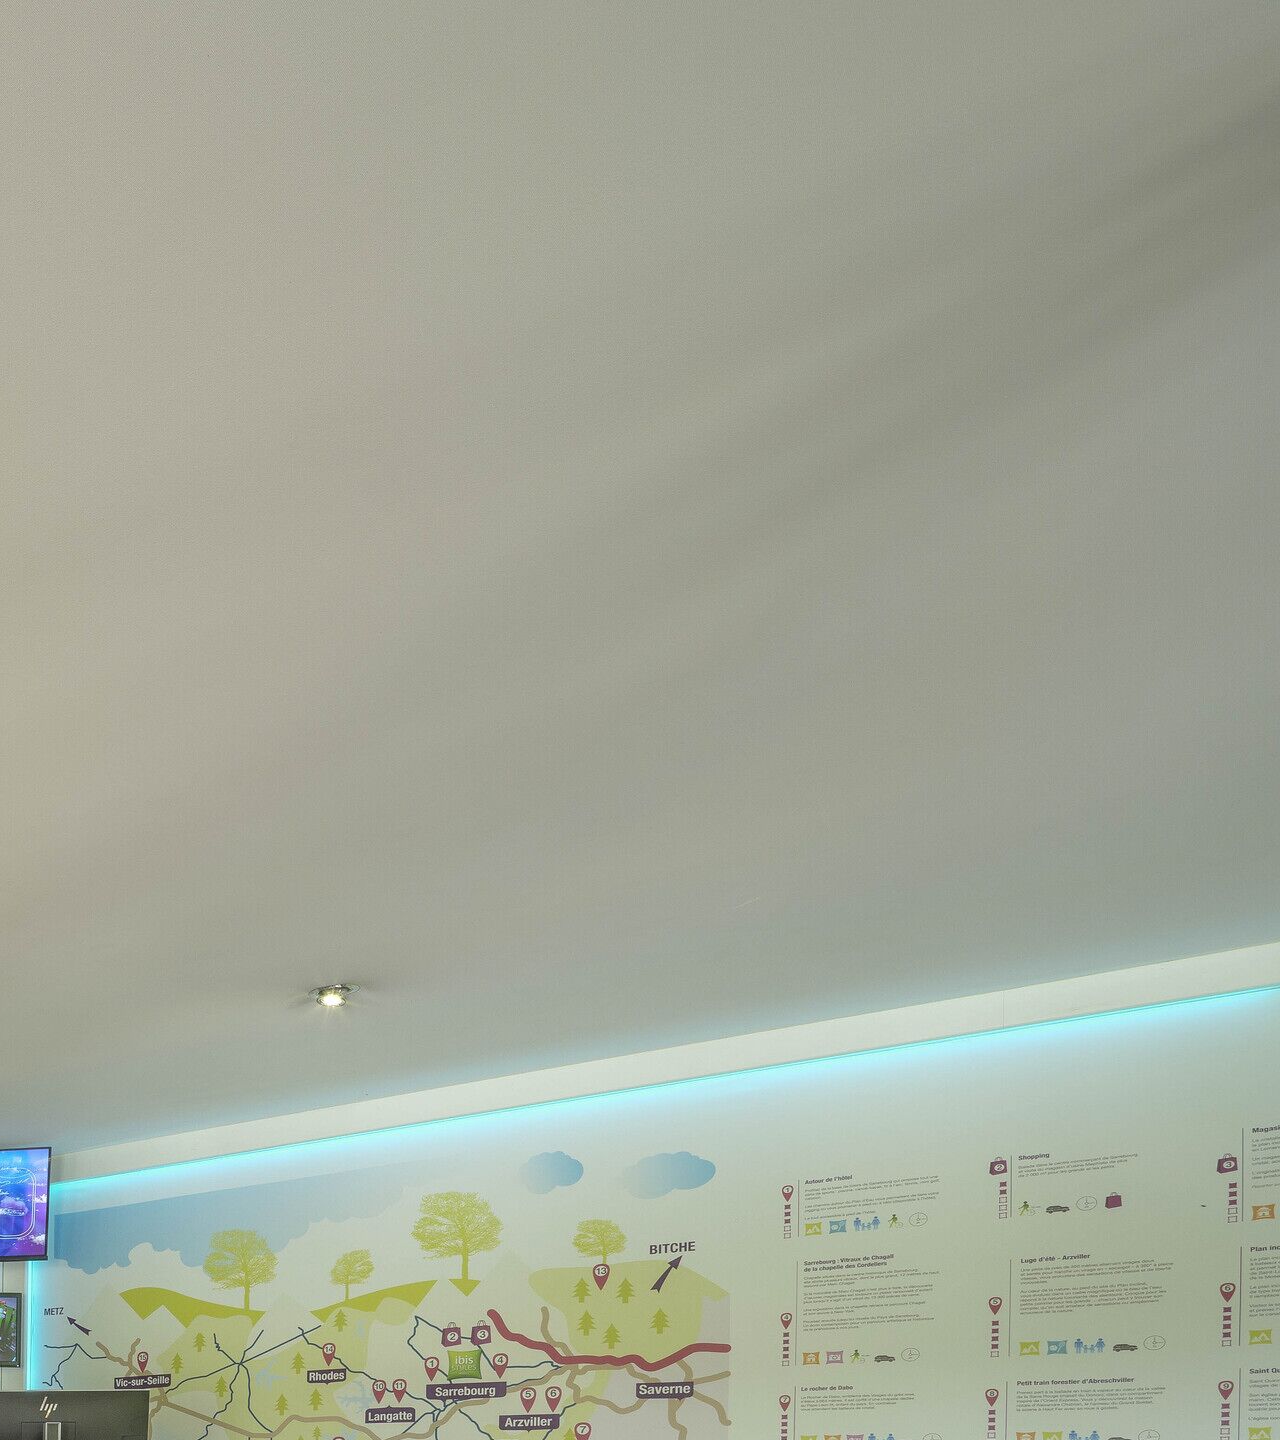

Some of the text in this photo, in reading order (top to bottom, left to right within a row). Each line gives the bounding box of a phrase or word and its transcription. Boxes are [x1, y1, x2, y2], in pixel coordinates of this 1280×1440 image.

[1018, 1152, 1050, 1161] Shopping
[649, 1241, 696, 1255] BITCHE
[804, 1259, 836, 1267] Sarrebourg
[871, 1253, 895, 1261] Chagall
[1020, 1257, 1037, 1265] Luge
[1062, 1253, 1090, 1261] Arzviller
[596, 1267, 607, 1276] 13
[819, 1264, 843, 1273] chapelle
[857, 1261, 887, 1269] Cordeliers
[43, 1307, 64, 1316] METZ
[449, 1333, 456, 1341] 2
[479, 1331, 486, 1339] 3
[324, 1345, 334, 1354] 14
[139, 1353, 147, 1362] 15
[455, 1355, 474, 1366] ibis
[497, 1357, 504, 1365] 4
[309, 1370, 345, 1382] Rhodes
[115, 1375, 170, 1388] Vic-sur-Seille
[395, 1381, 404, 1390] 11
[1051, 1378, 1080, 1386] forestier
[1081, 1377, 1135, 1385] d'Abreschviller
[374, 1382, 385, 1391] 10
[638, 1383, 691, 1396] Saverne
[435, 1384, 496, 1399] Sarrebourg
[525, 1390, 532, 1398] 5
[550, 1389, 557, 1398] 6
[368, 1410, 413, 1423] Langatte
[504, 1416, 553, 1428] Arzviller
[579, 1425, 586, 1434] 7
